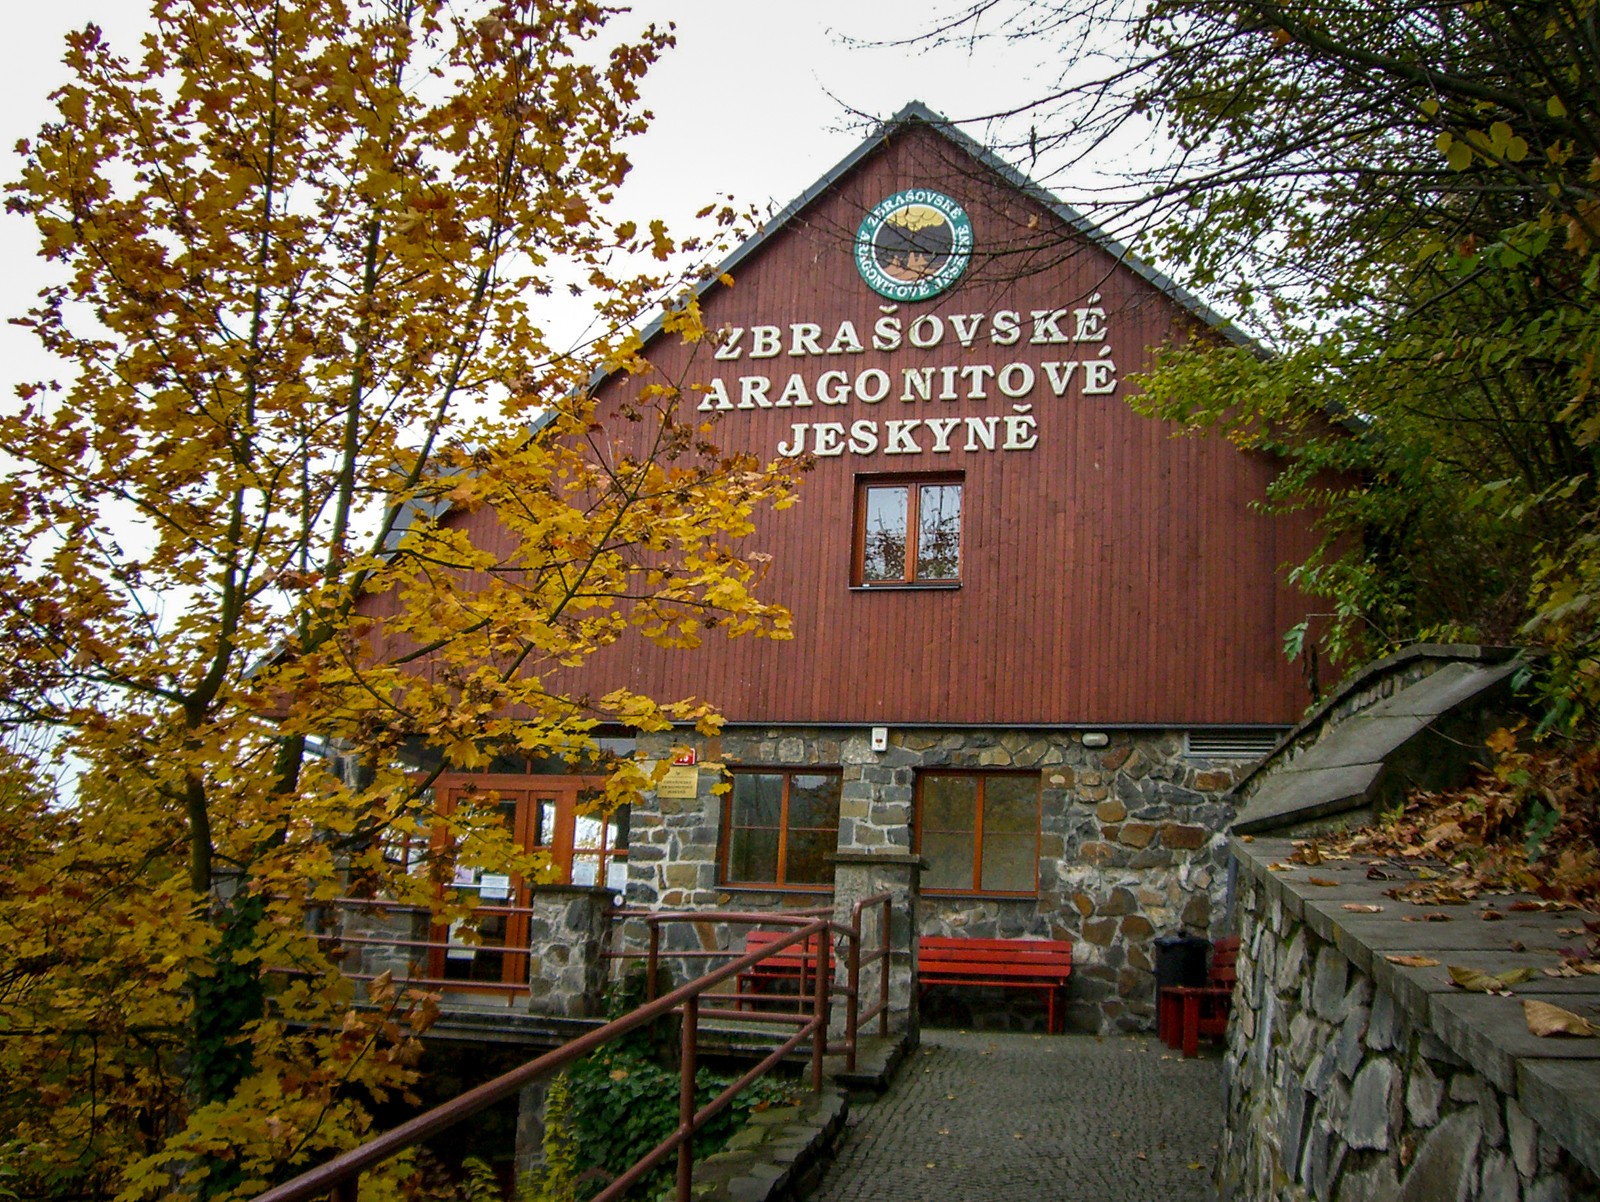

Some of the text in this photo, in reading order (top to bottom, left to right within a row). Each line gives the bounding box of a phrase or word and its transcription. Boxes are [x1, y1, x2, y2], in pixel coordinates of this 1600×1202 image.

[868, 189, 963, 226] ZBRAŠOVSKÉ
[858, 230, 930, 297] ARAGONITOVÉ
[714, 292, 1108, 361] ZBRAŠOVSKÉ
[697, 345, 1118, 412] ARAGONITOVÉ
[777, 403, 1038, 457] JESKYNĚ
